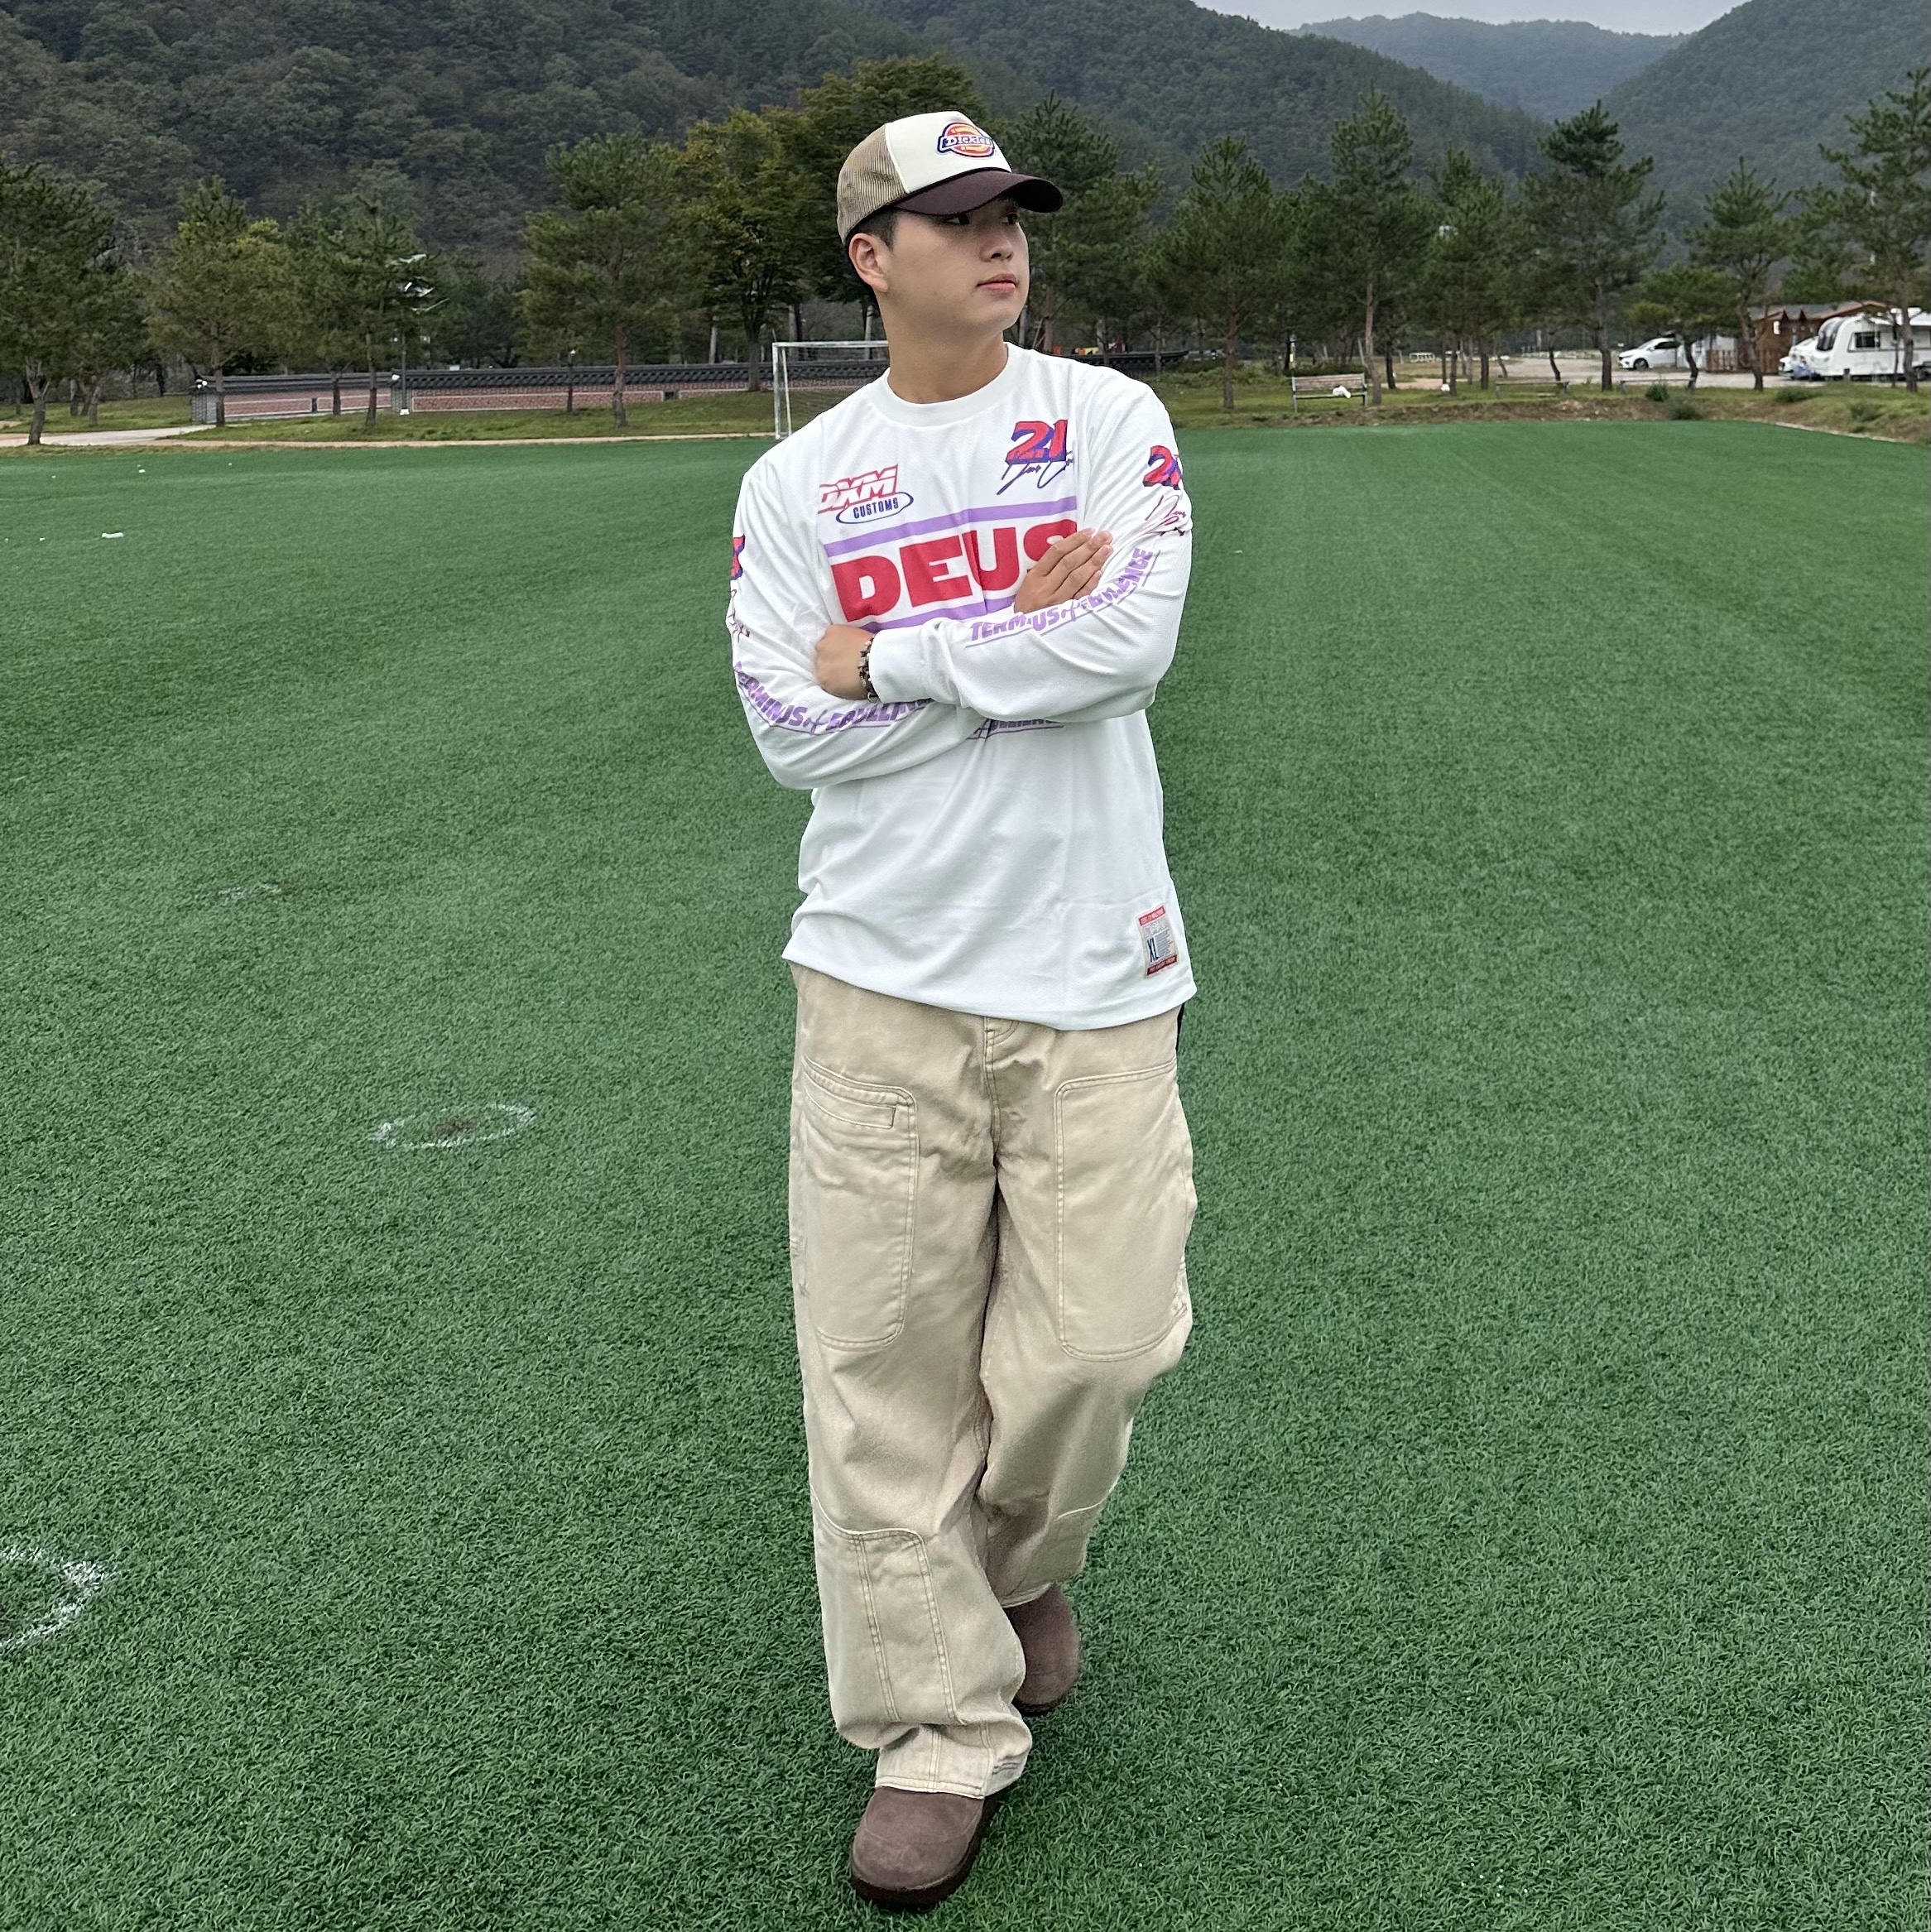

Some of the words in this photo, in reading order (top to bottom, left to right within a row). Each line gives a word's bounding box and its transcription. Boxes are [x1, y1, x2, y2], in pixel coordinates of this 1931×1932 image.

[1004, 419, 1068, 465] 21
[853, 497, 900, 519] CUSTOMS
[971, 607, 1059, 642] TERMUS
[1146, 937, 1160, 964] XL
